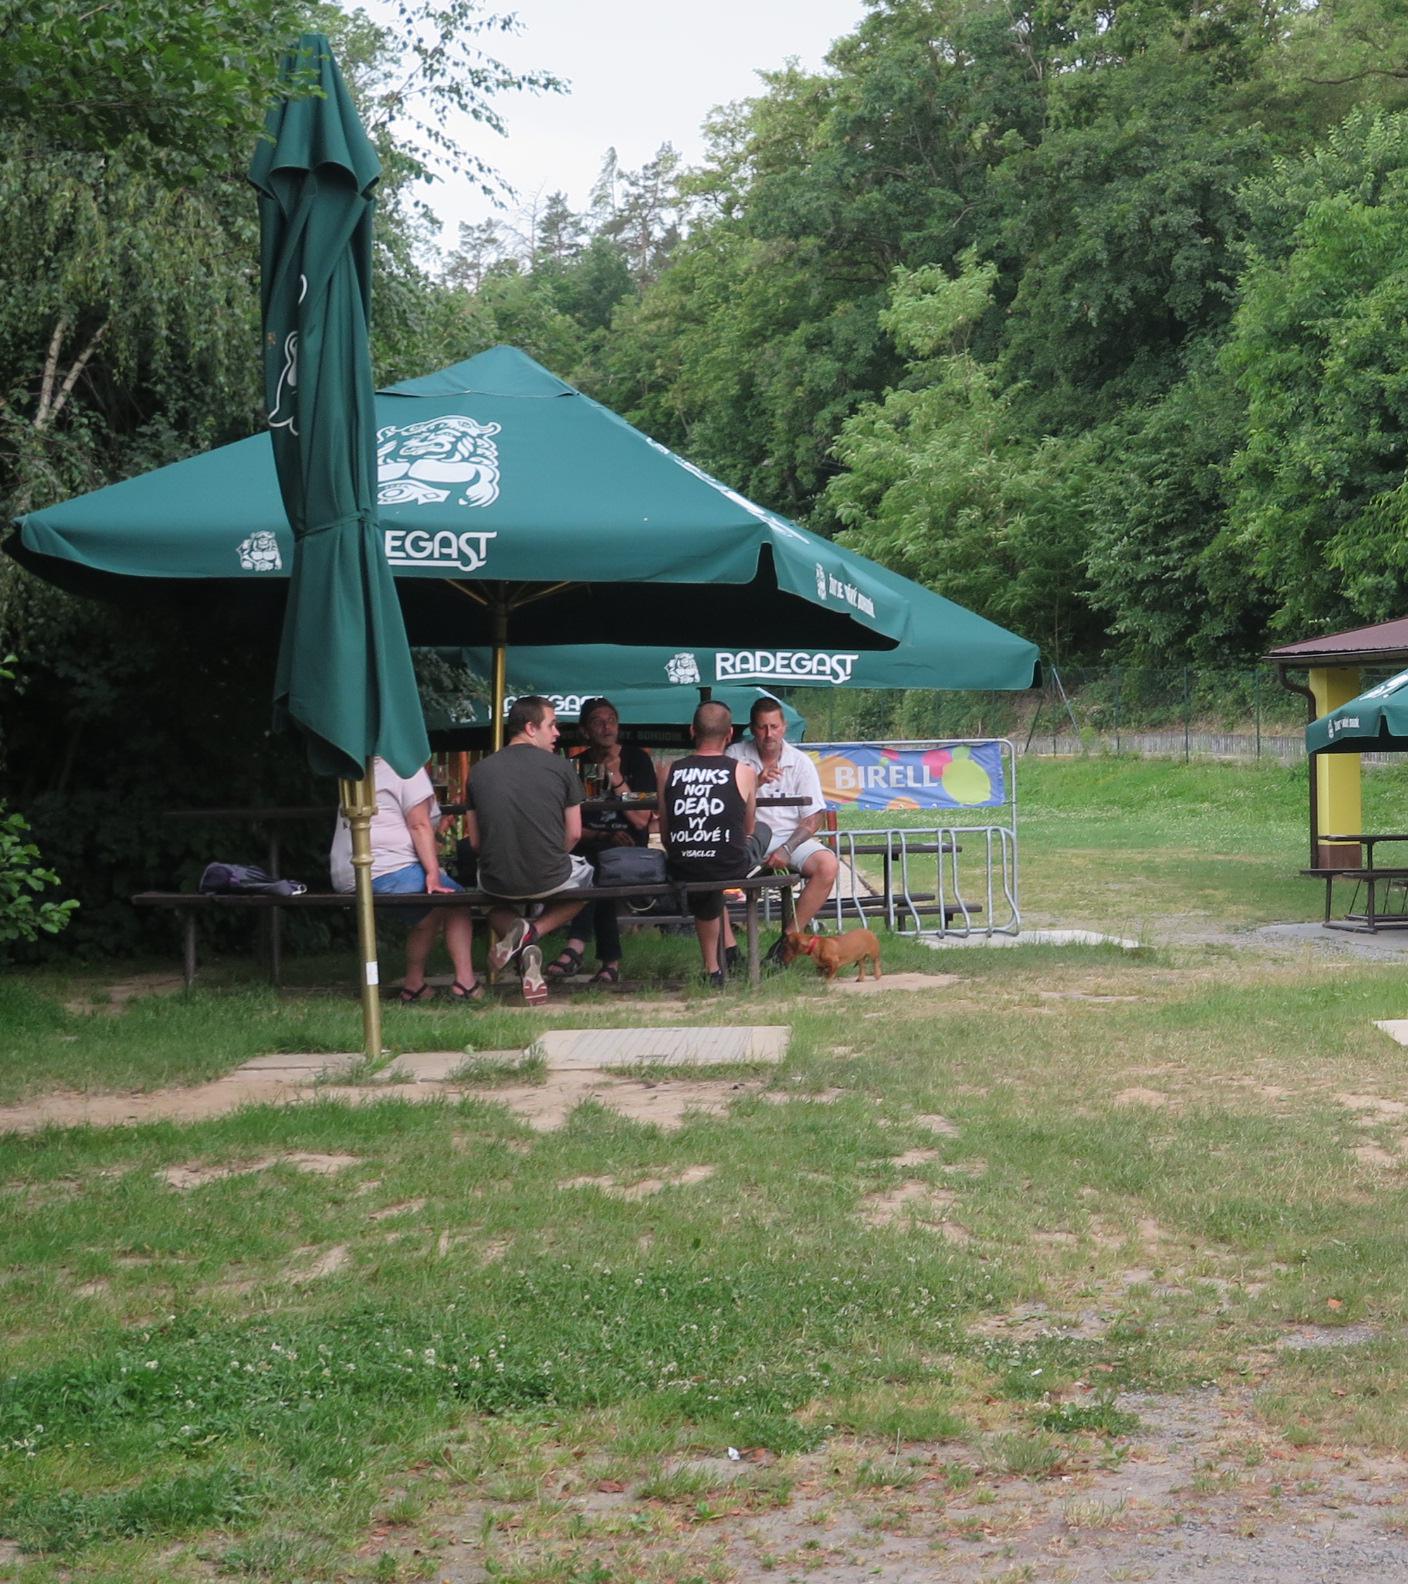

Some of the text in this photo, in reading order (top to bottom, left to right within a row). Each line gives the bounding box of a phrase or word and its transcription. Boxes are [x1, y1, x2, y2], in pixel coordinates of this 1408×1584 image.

[384, 530, 498, 573] EGAST
[715, 651, 860, 685] RADEGAST
[672, 768, 730, 787] PUNKS
[834, 765, 938, 790] BIRELL
[684, 784, 714, 798] NOT
[674, 797, 725, 817] DEAD
[688, 817, 708, 829] VY
